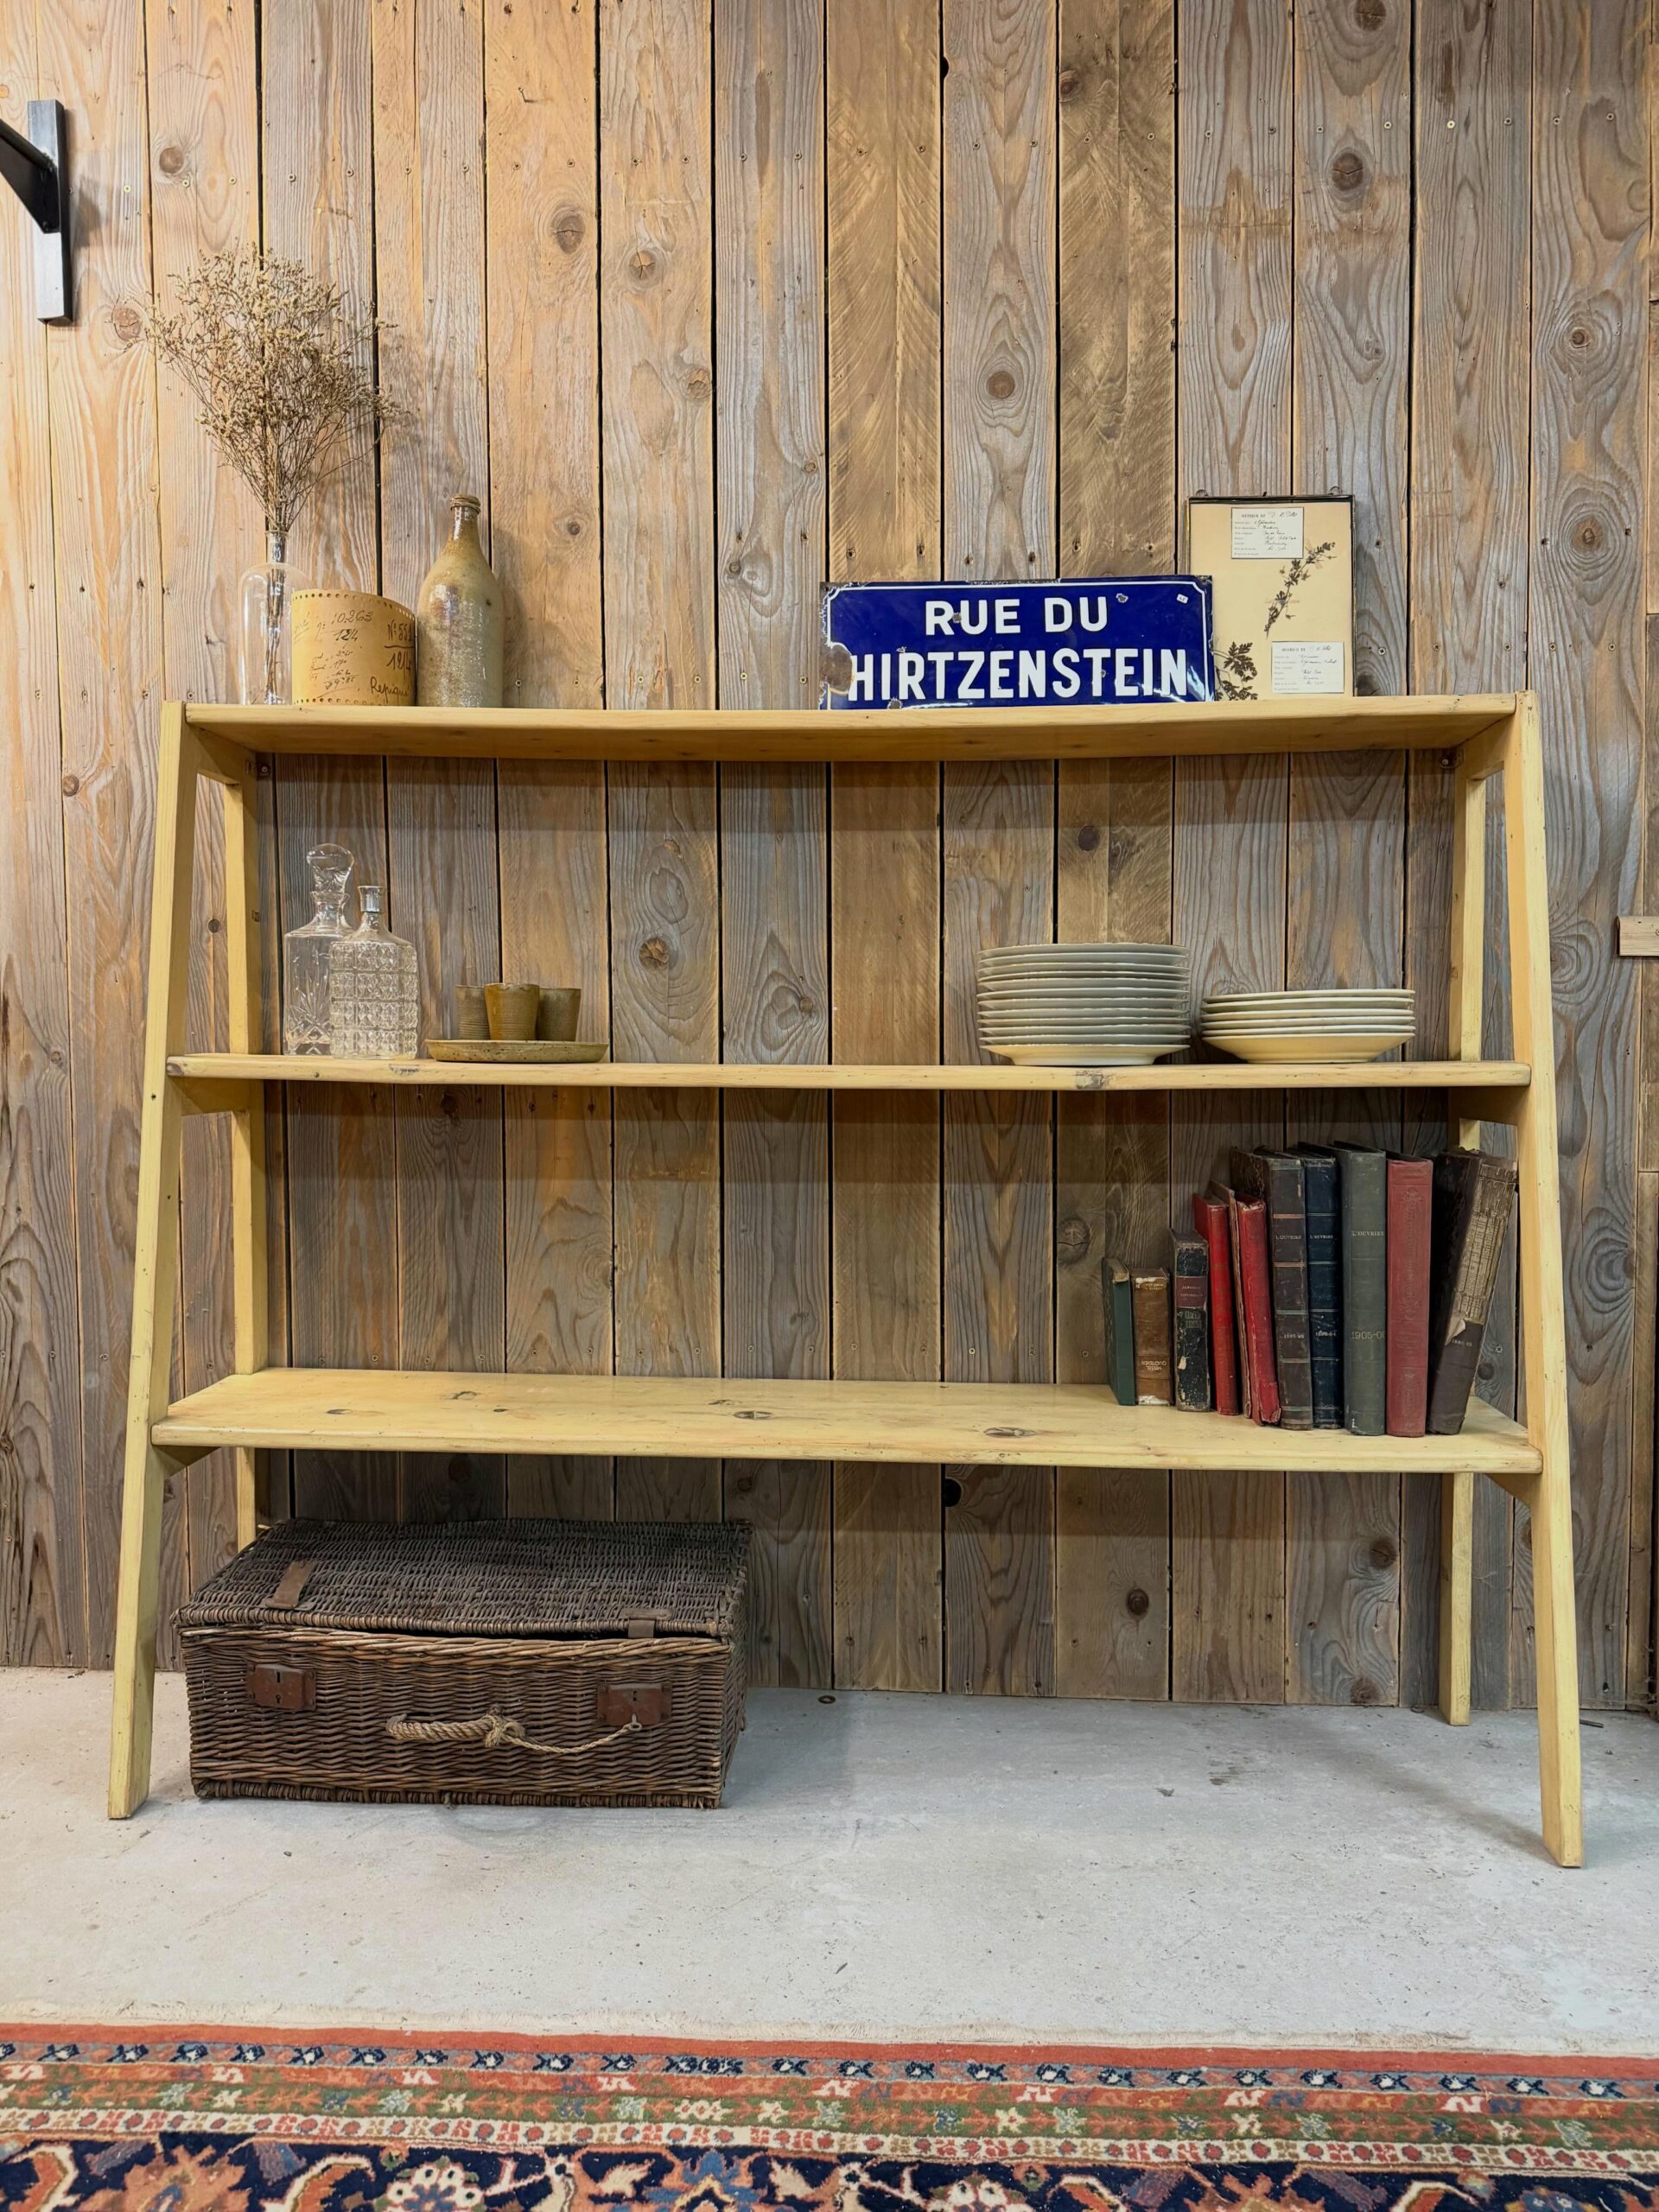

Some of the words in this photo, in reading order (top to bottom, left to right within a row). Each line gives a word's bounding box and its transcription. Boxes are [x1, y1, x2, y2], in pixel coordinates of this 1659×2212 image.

[925, 599, 1020, 636] RUE
[1045, 596, 1108, 632] DU
[848, 648, 1187, 702] HIRTZENSTEIN
